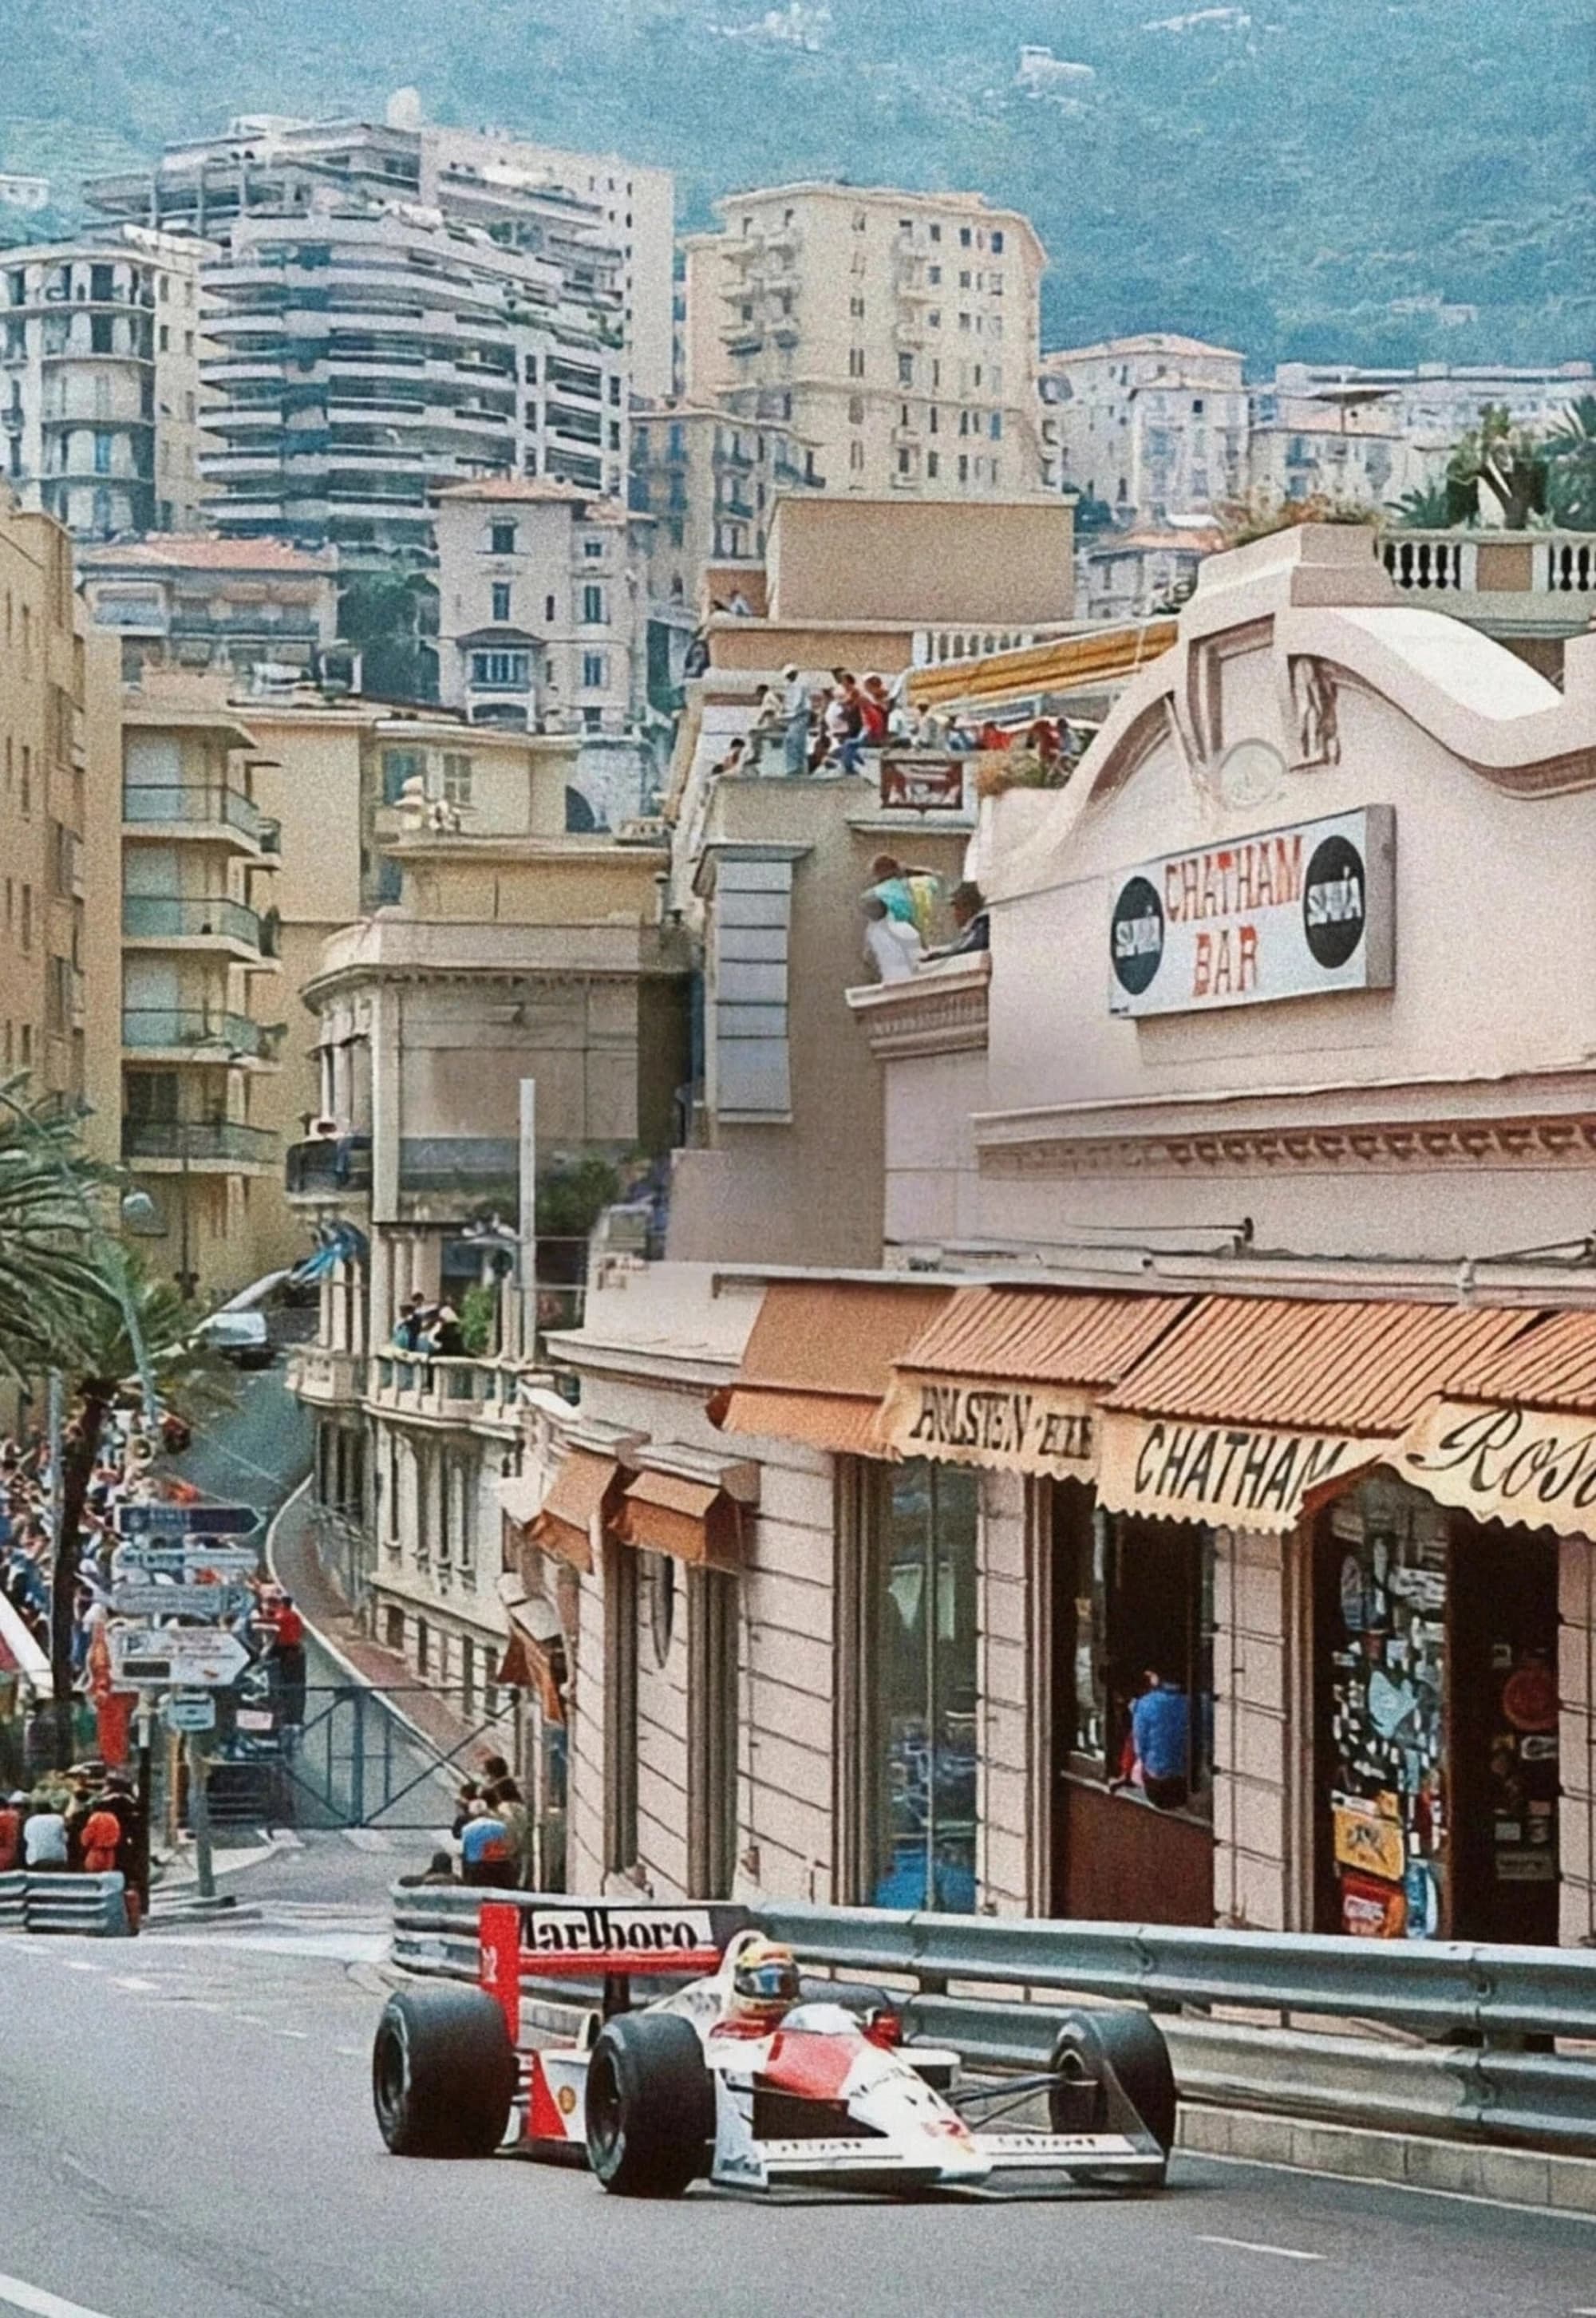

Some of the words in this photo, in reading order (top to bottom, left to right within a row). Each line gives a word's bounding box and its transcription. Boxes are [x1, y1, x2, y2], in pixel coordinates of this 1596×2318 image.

[1165, 835, 1303, 923] CHATHAM
[1193, 925, 1258, 997] BAR
[1134, 1422, 1349, 1513] CHATHAM
